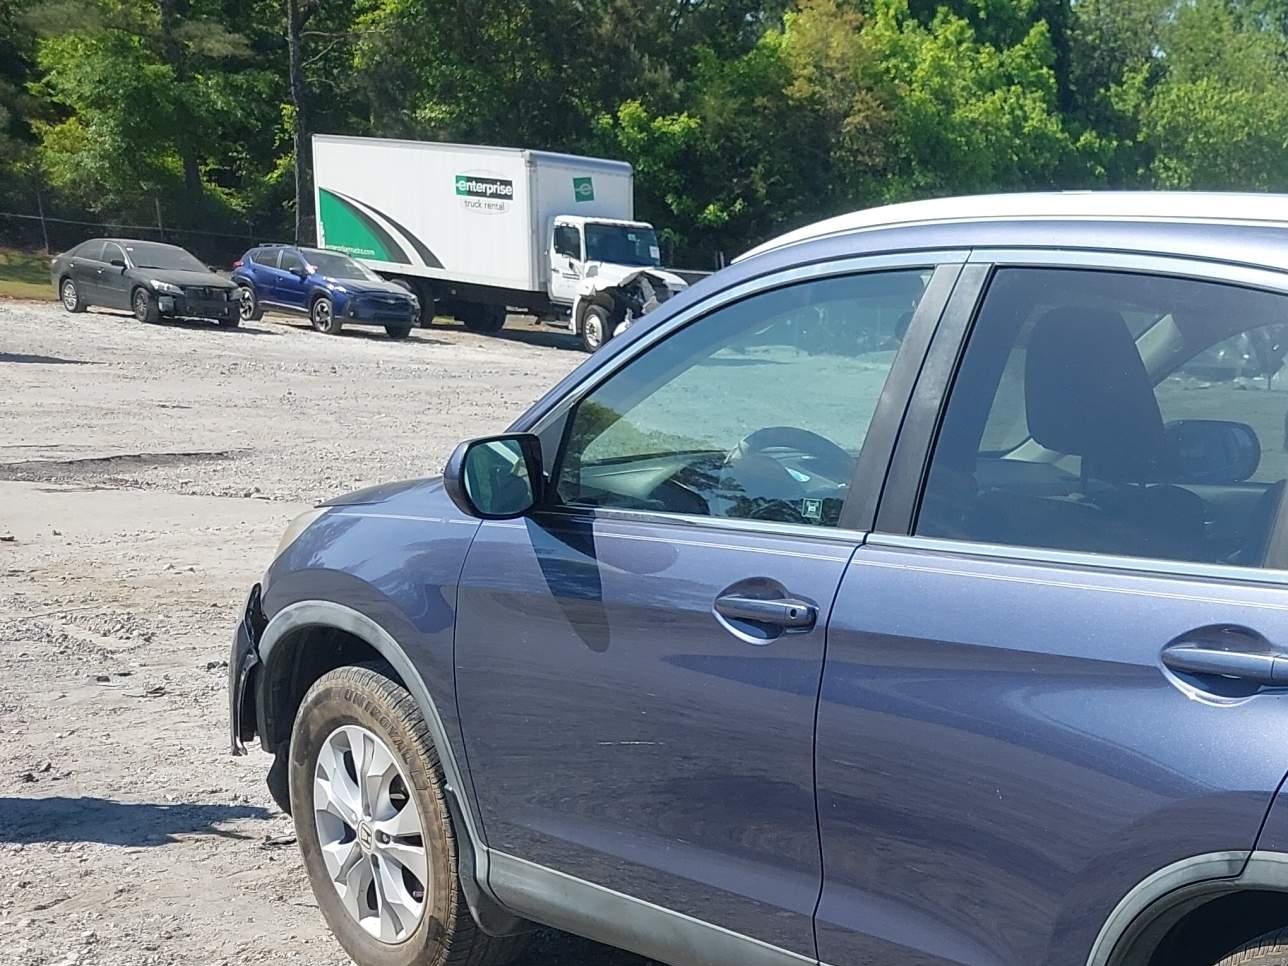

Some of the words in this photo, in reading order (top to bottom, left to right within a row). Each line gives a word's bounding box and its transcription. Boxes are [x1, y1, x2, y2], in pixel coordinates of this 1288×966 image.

[457, 180, 513, 196] enterprise
[464, 199, 482, 209] truck
[484, 201, 505, 210] rental
